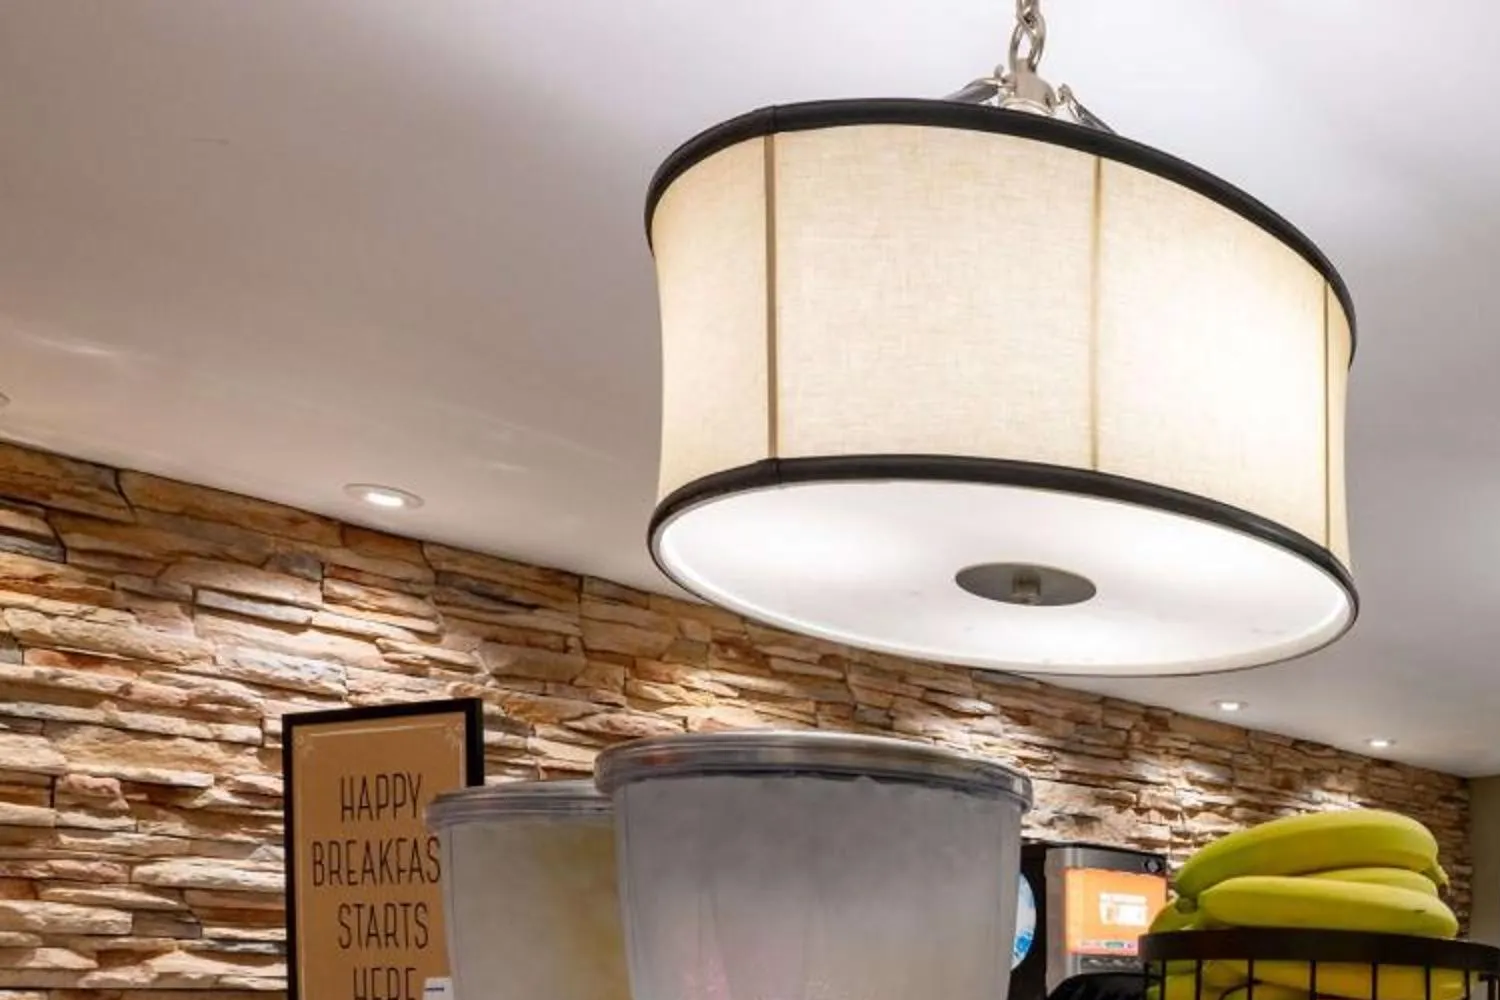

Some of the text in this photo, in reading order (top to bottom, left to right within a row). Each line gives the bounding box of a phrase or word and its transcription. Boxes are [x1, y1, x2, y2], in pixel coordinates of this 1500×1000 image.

[341, 772, 422, 822] HAPPY
[312, 836, 441, 887] BREAKFAS
[338, 902, 429, 950] STARTS
